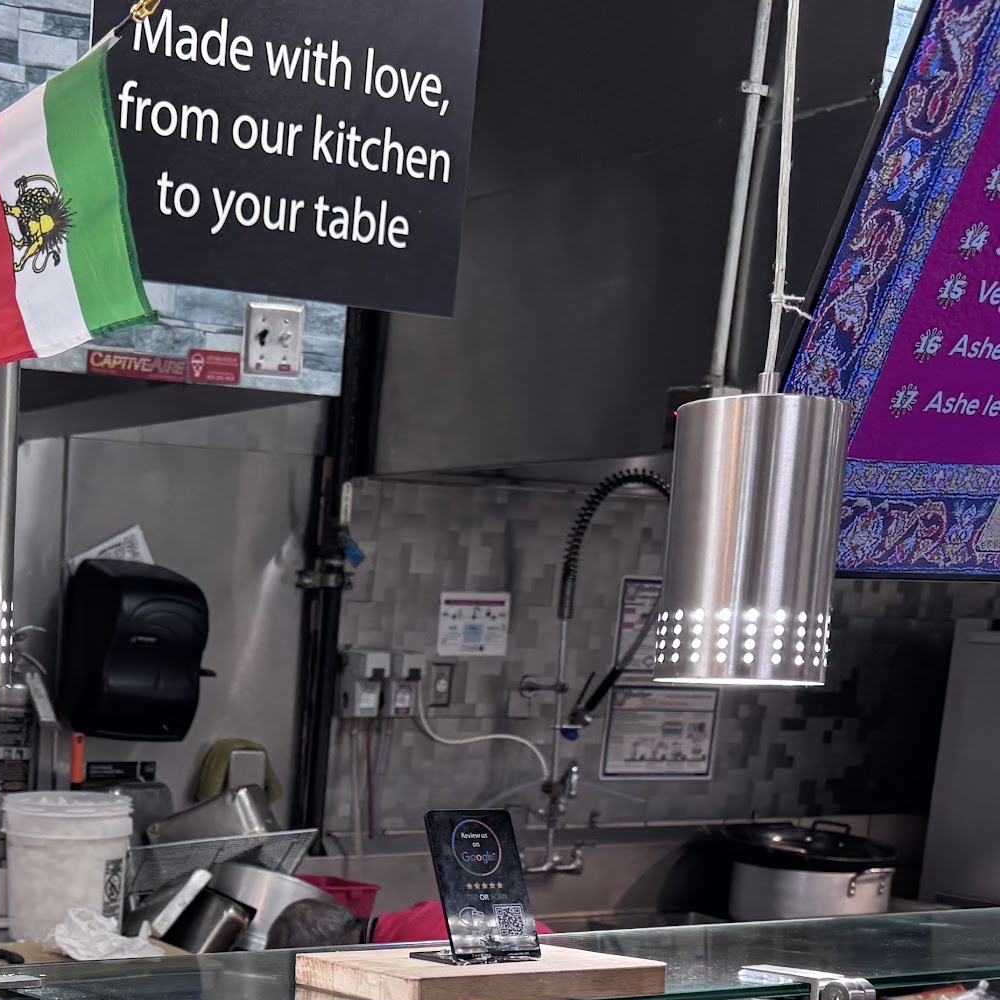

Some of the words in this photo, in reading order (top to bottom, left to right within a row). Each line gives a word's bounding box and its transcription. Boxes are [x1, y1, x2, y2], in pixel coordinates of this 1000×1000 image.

[132, 8, 254, 72] Made
[265, 37, 352, 91] with
[364, 47, 451, 117] love,
[118, 81, 219, 144] from
[231, 113, 303, 157] our
[313, 114, 451, 183] kitchen
[157, 171, 200, 218] to
[210, 187, 304, 235] your
[314, 195, 410, 249] table
[941, 279, 968, 300] 15
[917, 334, 942, 353] 16
[923, 390, 979, 416] Ashe
[461, 851, 495, 864] Google
